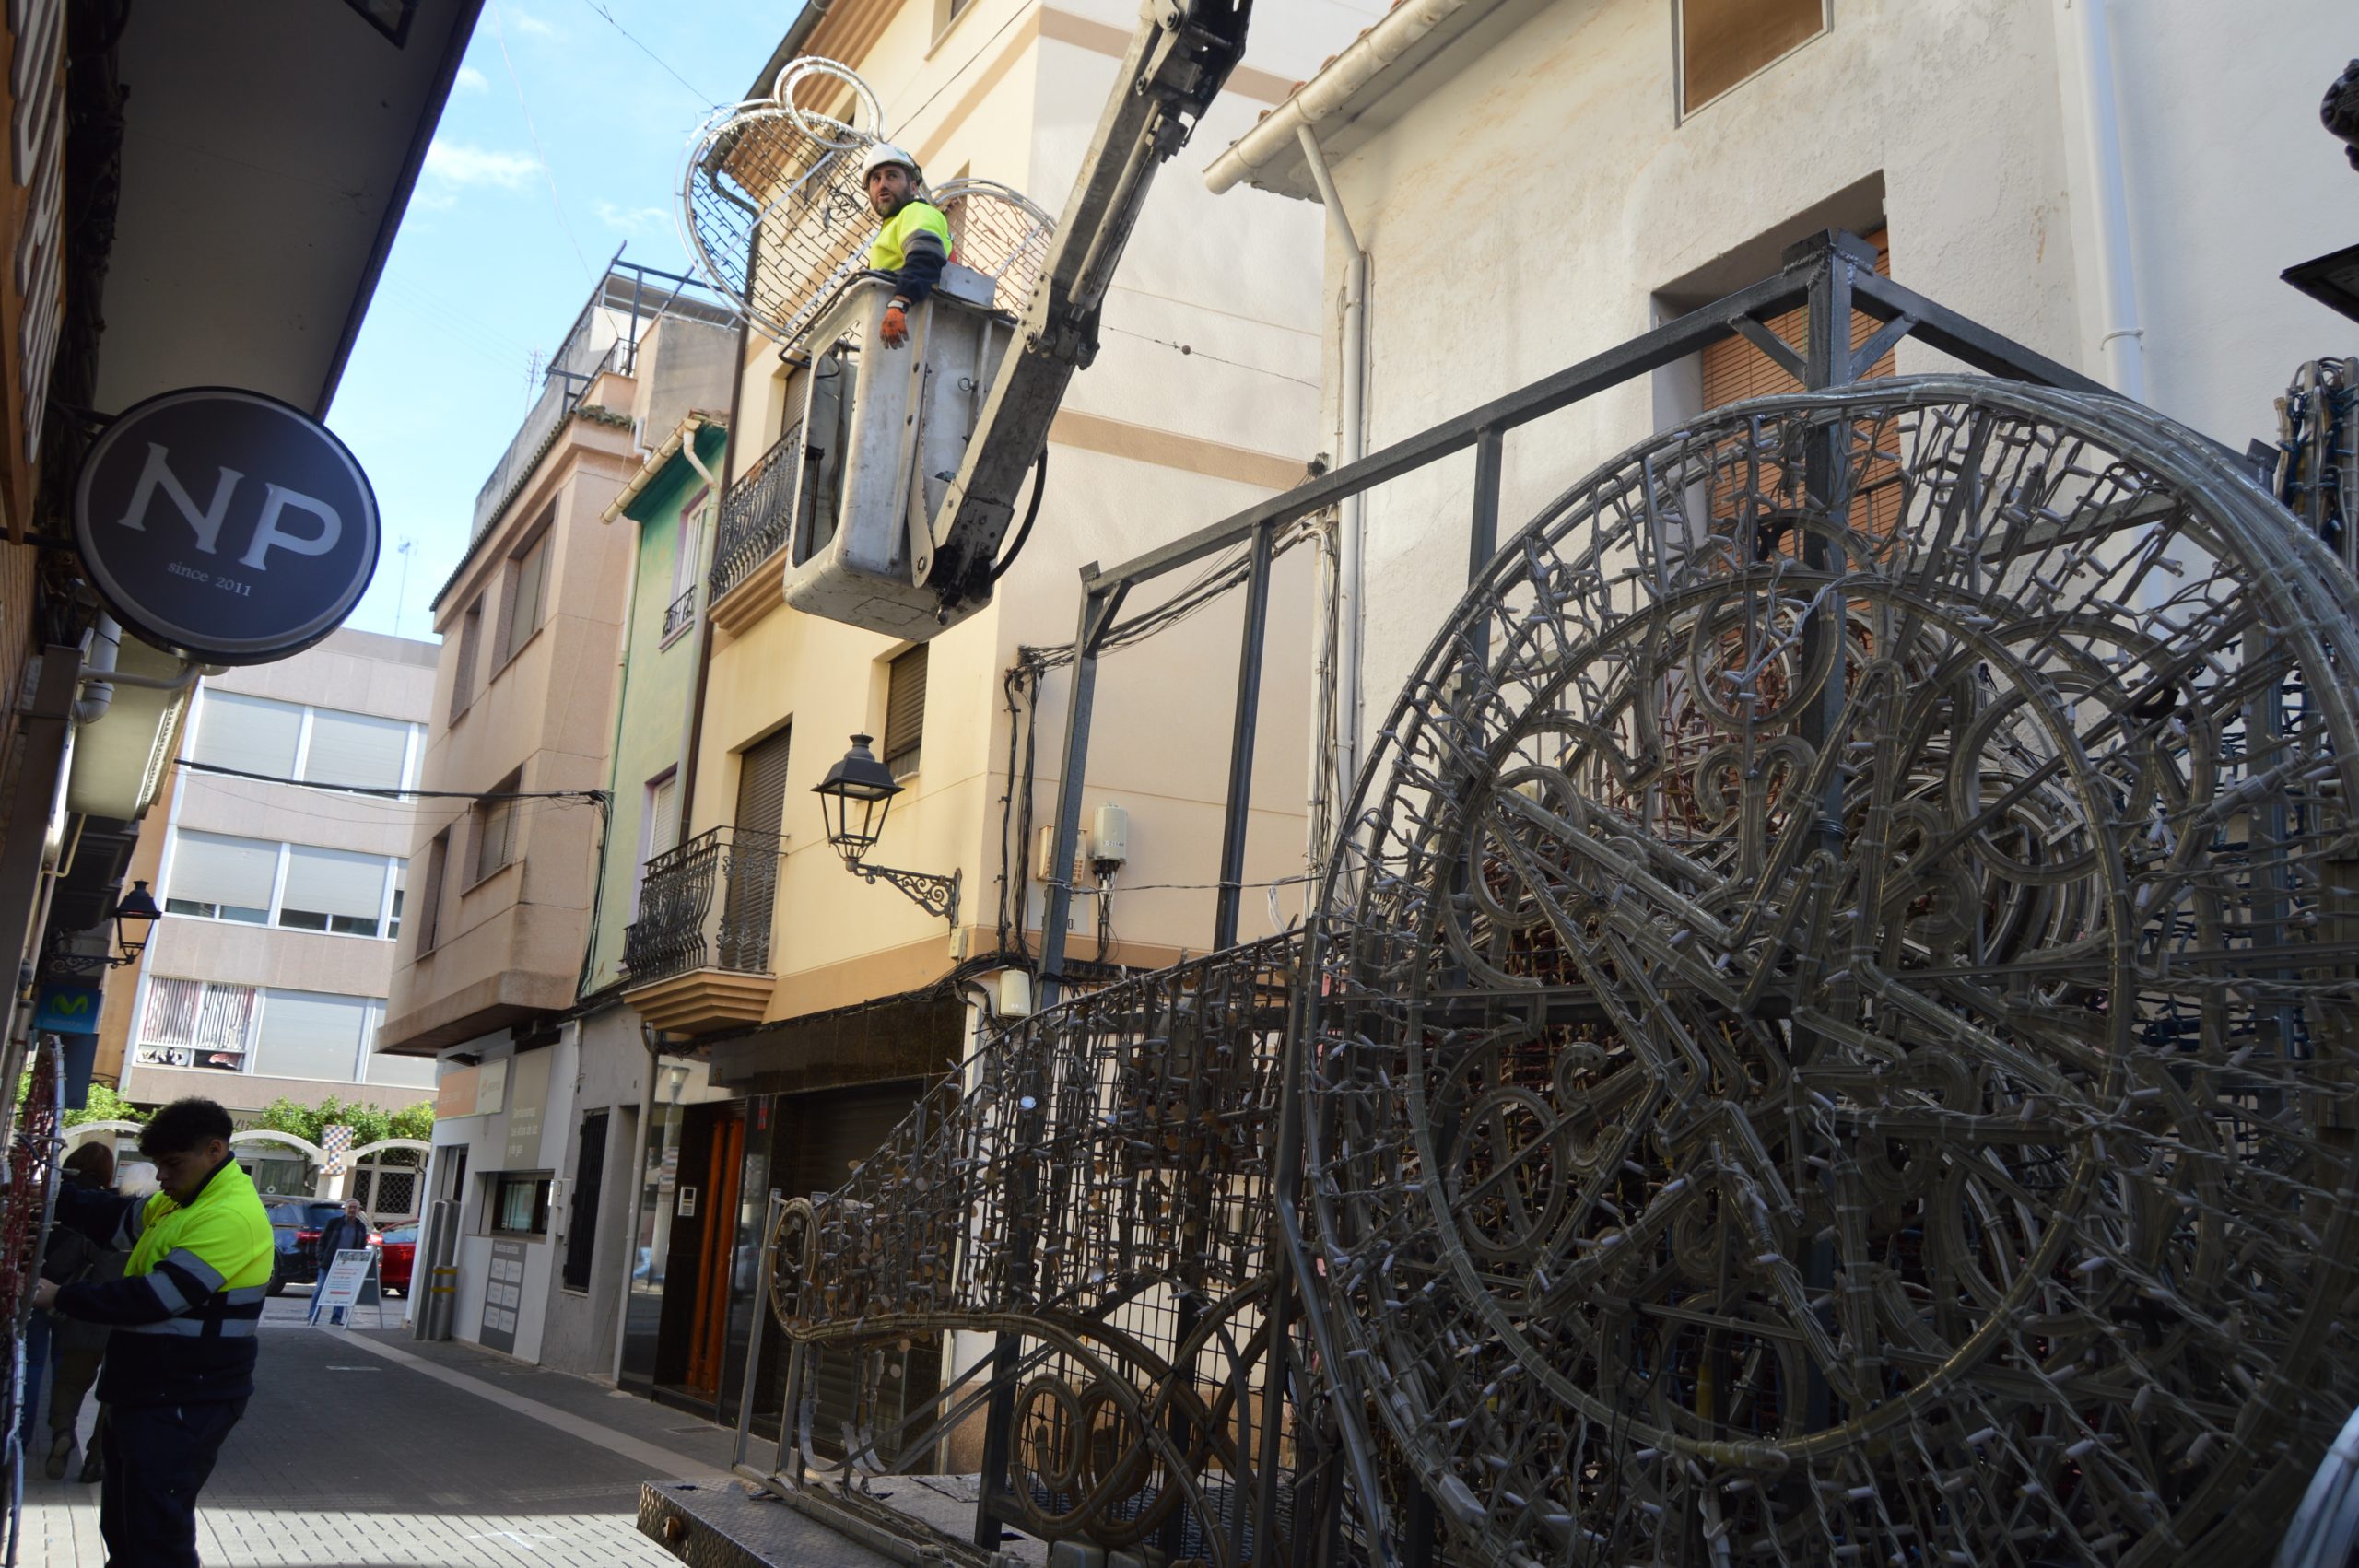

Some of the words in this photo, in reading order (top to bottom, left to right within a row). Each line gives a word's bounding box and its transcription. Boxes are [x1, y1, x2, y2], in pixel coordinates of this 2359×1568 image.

[117, 441, 343, 572] NP
[168, 560, 209, 583] since
[215, 576, 252, 597] 2011
